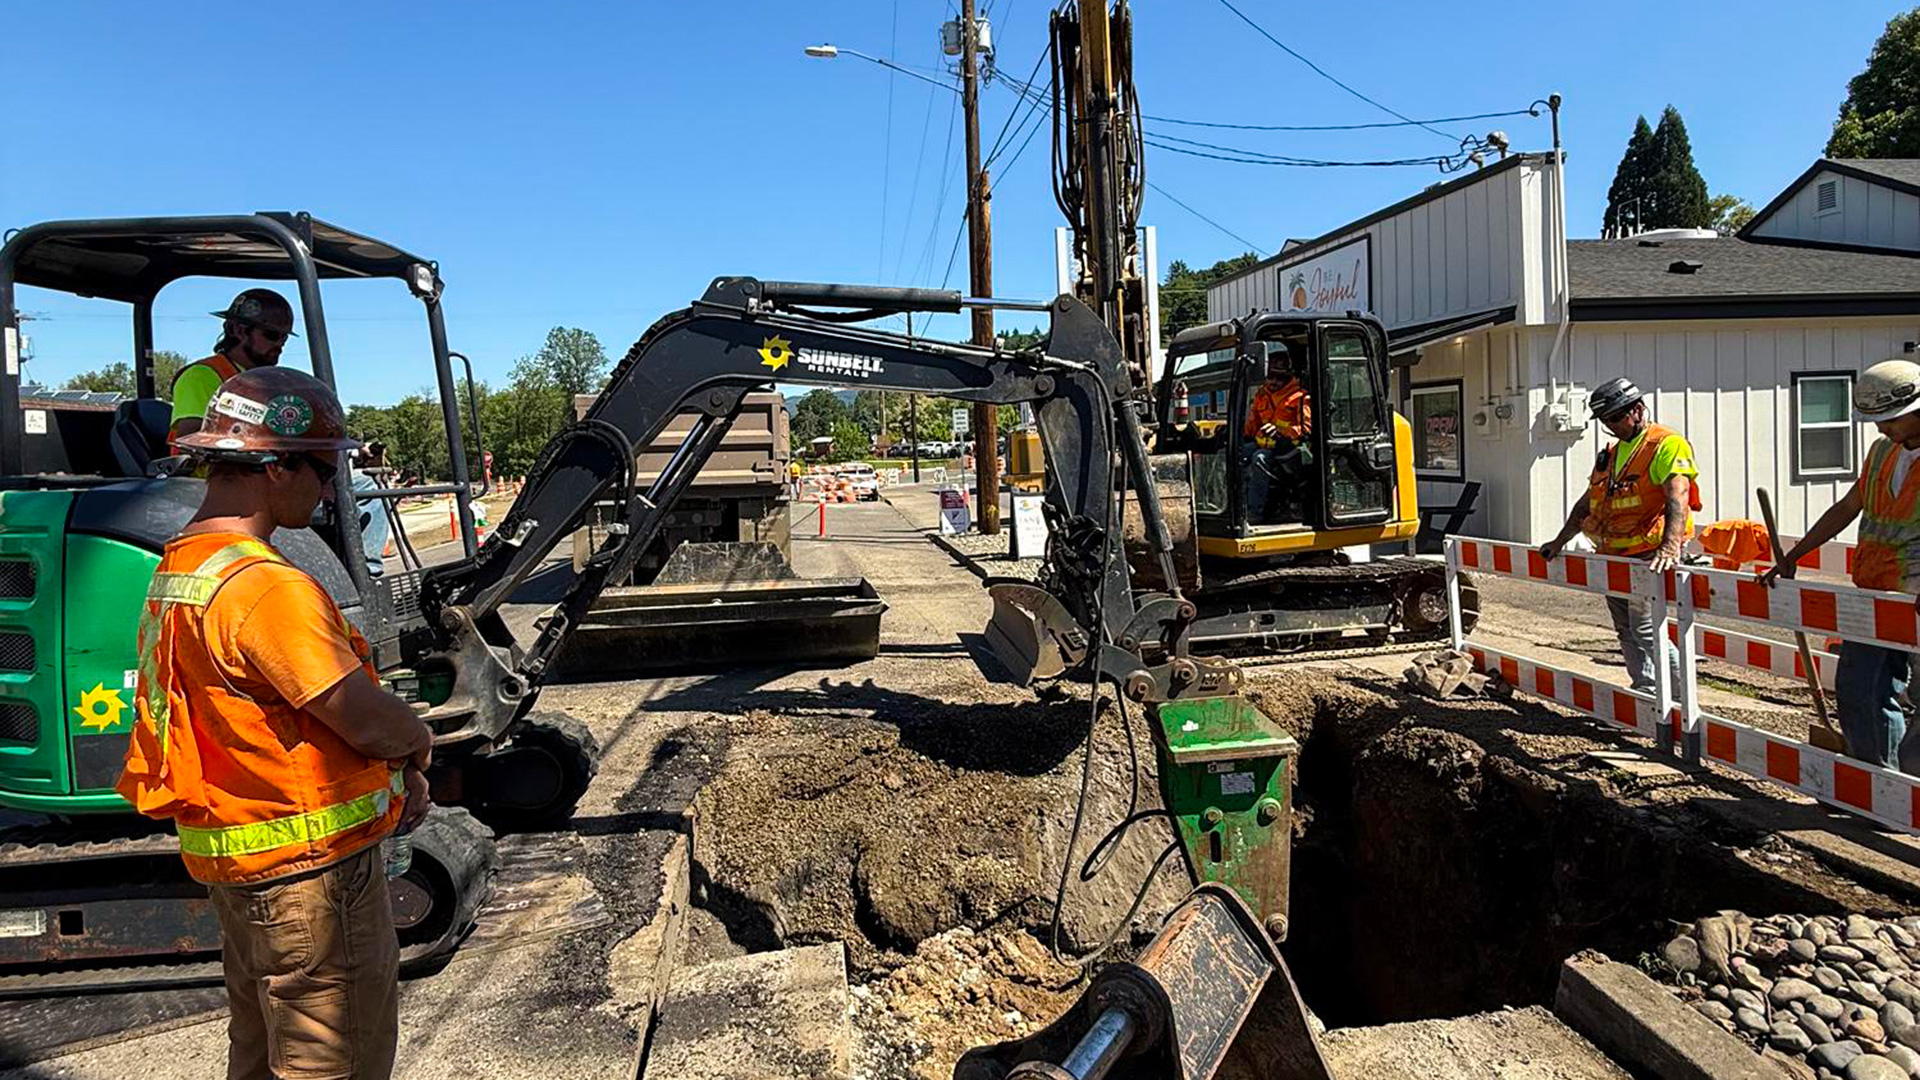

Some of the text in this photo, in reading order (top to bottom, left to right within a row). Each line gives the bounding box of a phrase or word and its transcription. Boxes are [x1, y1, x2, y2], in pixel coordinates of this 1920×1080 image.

[807, 364, 869, 378] RENTALS
[238, 408, 261, 421] SAFETY
[1425, 416, 1456, 433] OPEN
